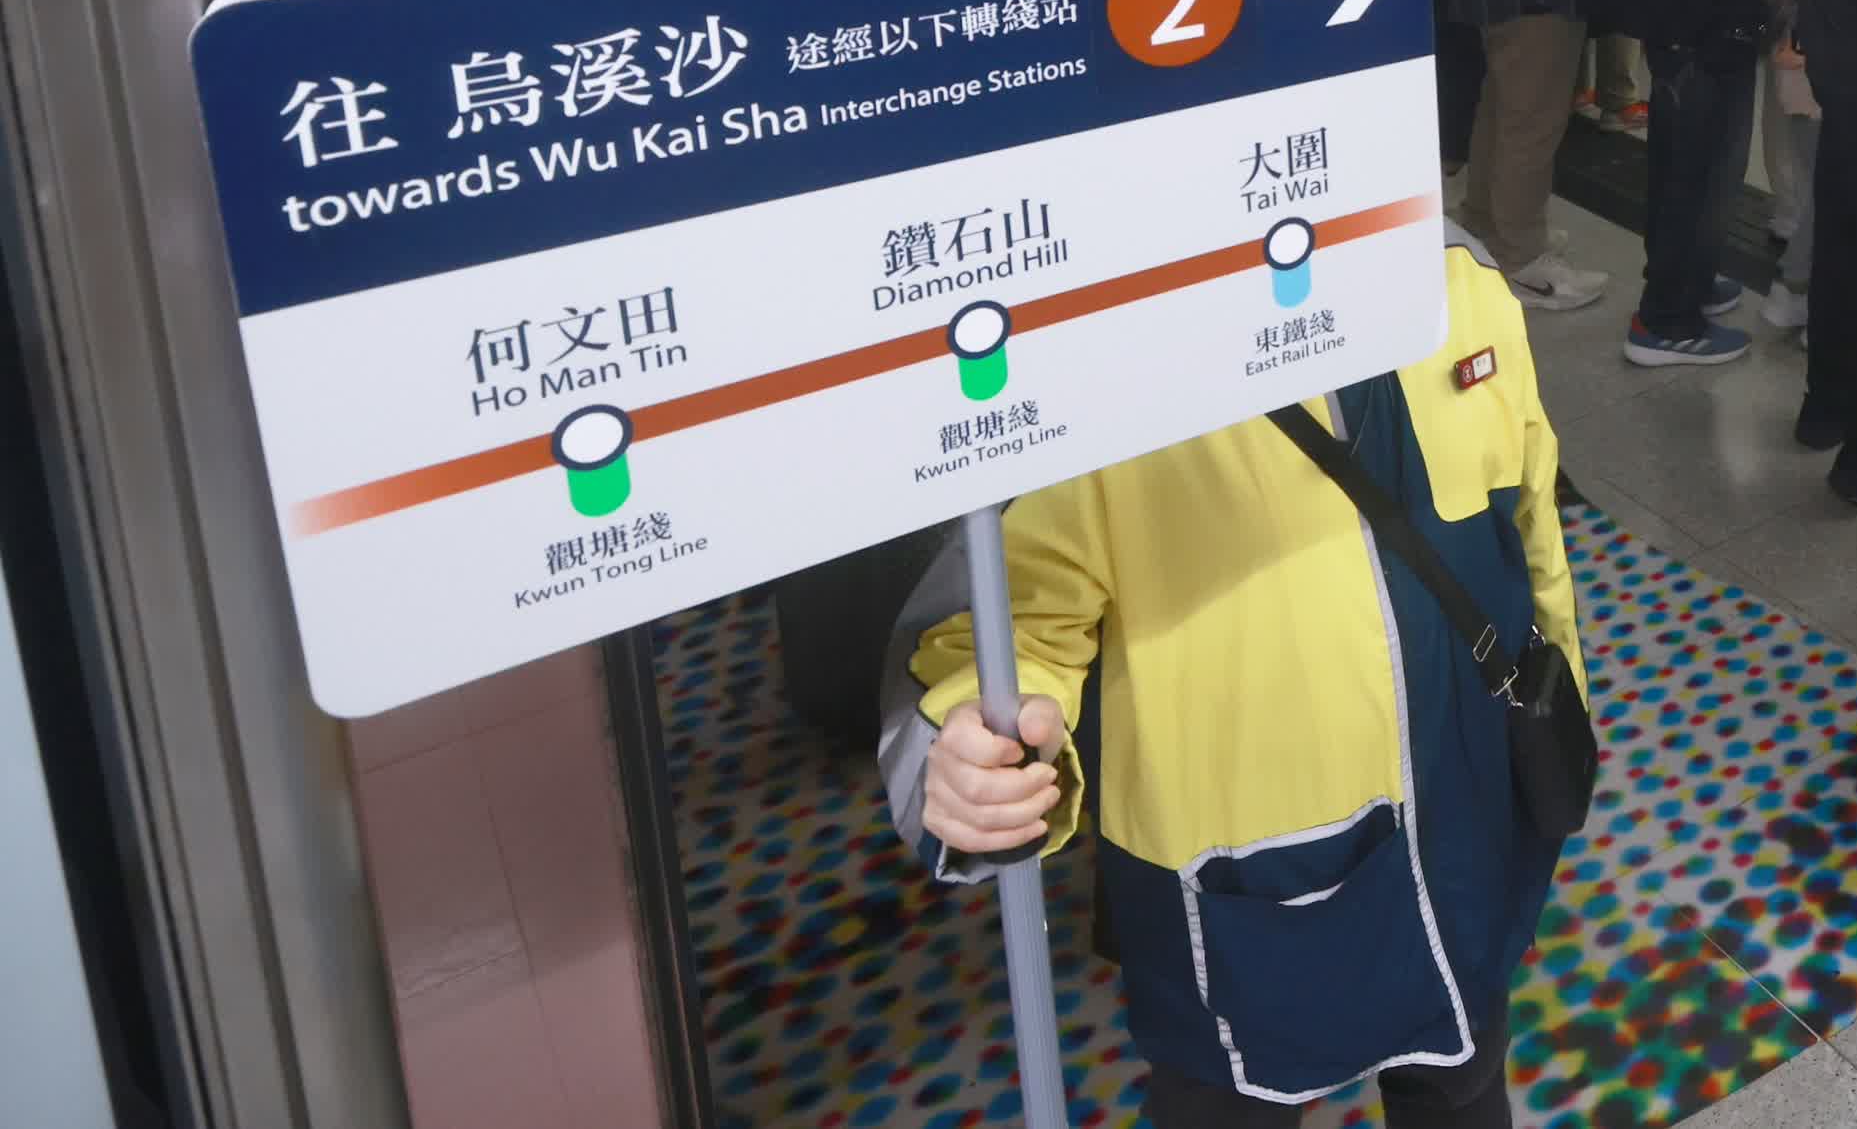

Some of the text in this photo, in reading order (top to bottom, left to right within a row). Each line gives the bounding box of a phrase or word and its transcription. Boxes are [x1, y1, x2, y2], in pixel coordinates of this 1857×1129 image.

[280, 15, 749, 168] 往 烏溪沙
[820, 57, 1087, 127] Interchange Stations
[282, 100, 808, 233] towards Wu Kai Sha
[1239, 126, 1328, 190] 大圍
[1241, 172, 1329, 214] Tai Wai
[881, 198, 1050, 279] 鑽石山
[872, 238, 1069, 312] Diamond Hill
[466, 286, 678, 384] 何文田
[1245, 336, 1346, 377] East Rail Line
[1253, 309, 1336, 354] 東鐵綫
[471, 343, 688, 417] Ho Man Tin
[914, 423, 1068, 483] Kwun Tong Line
[940, 399, 1040, 454] 觀塘綫
[514, 536, 709, 610] Kwun Tong Line
[544, 510, 673, 576] 觀塘綫
